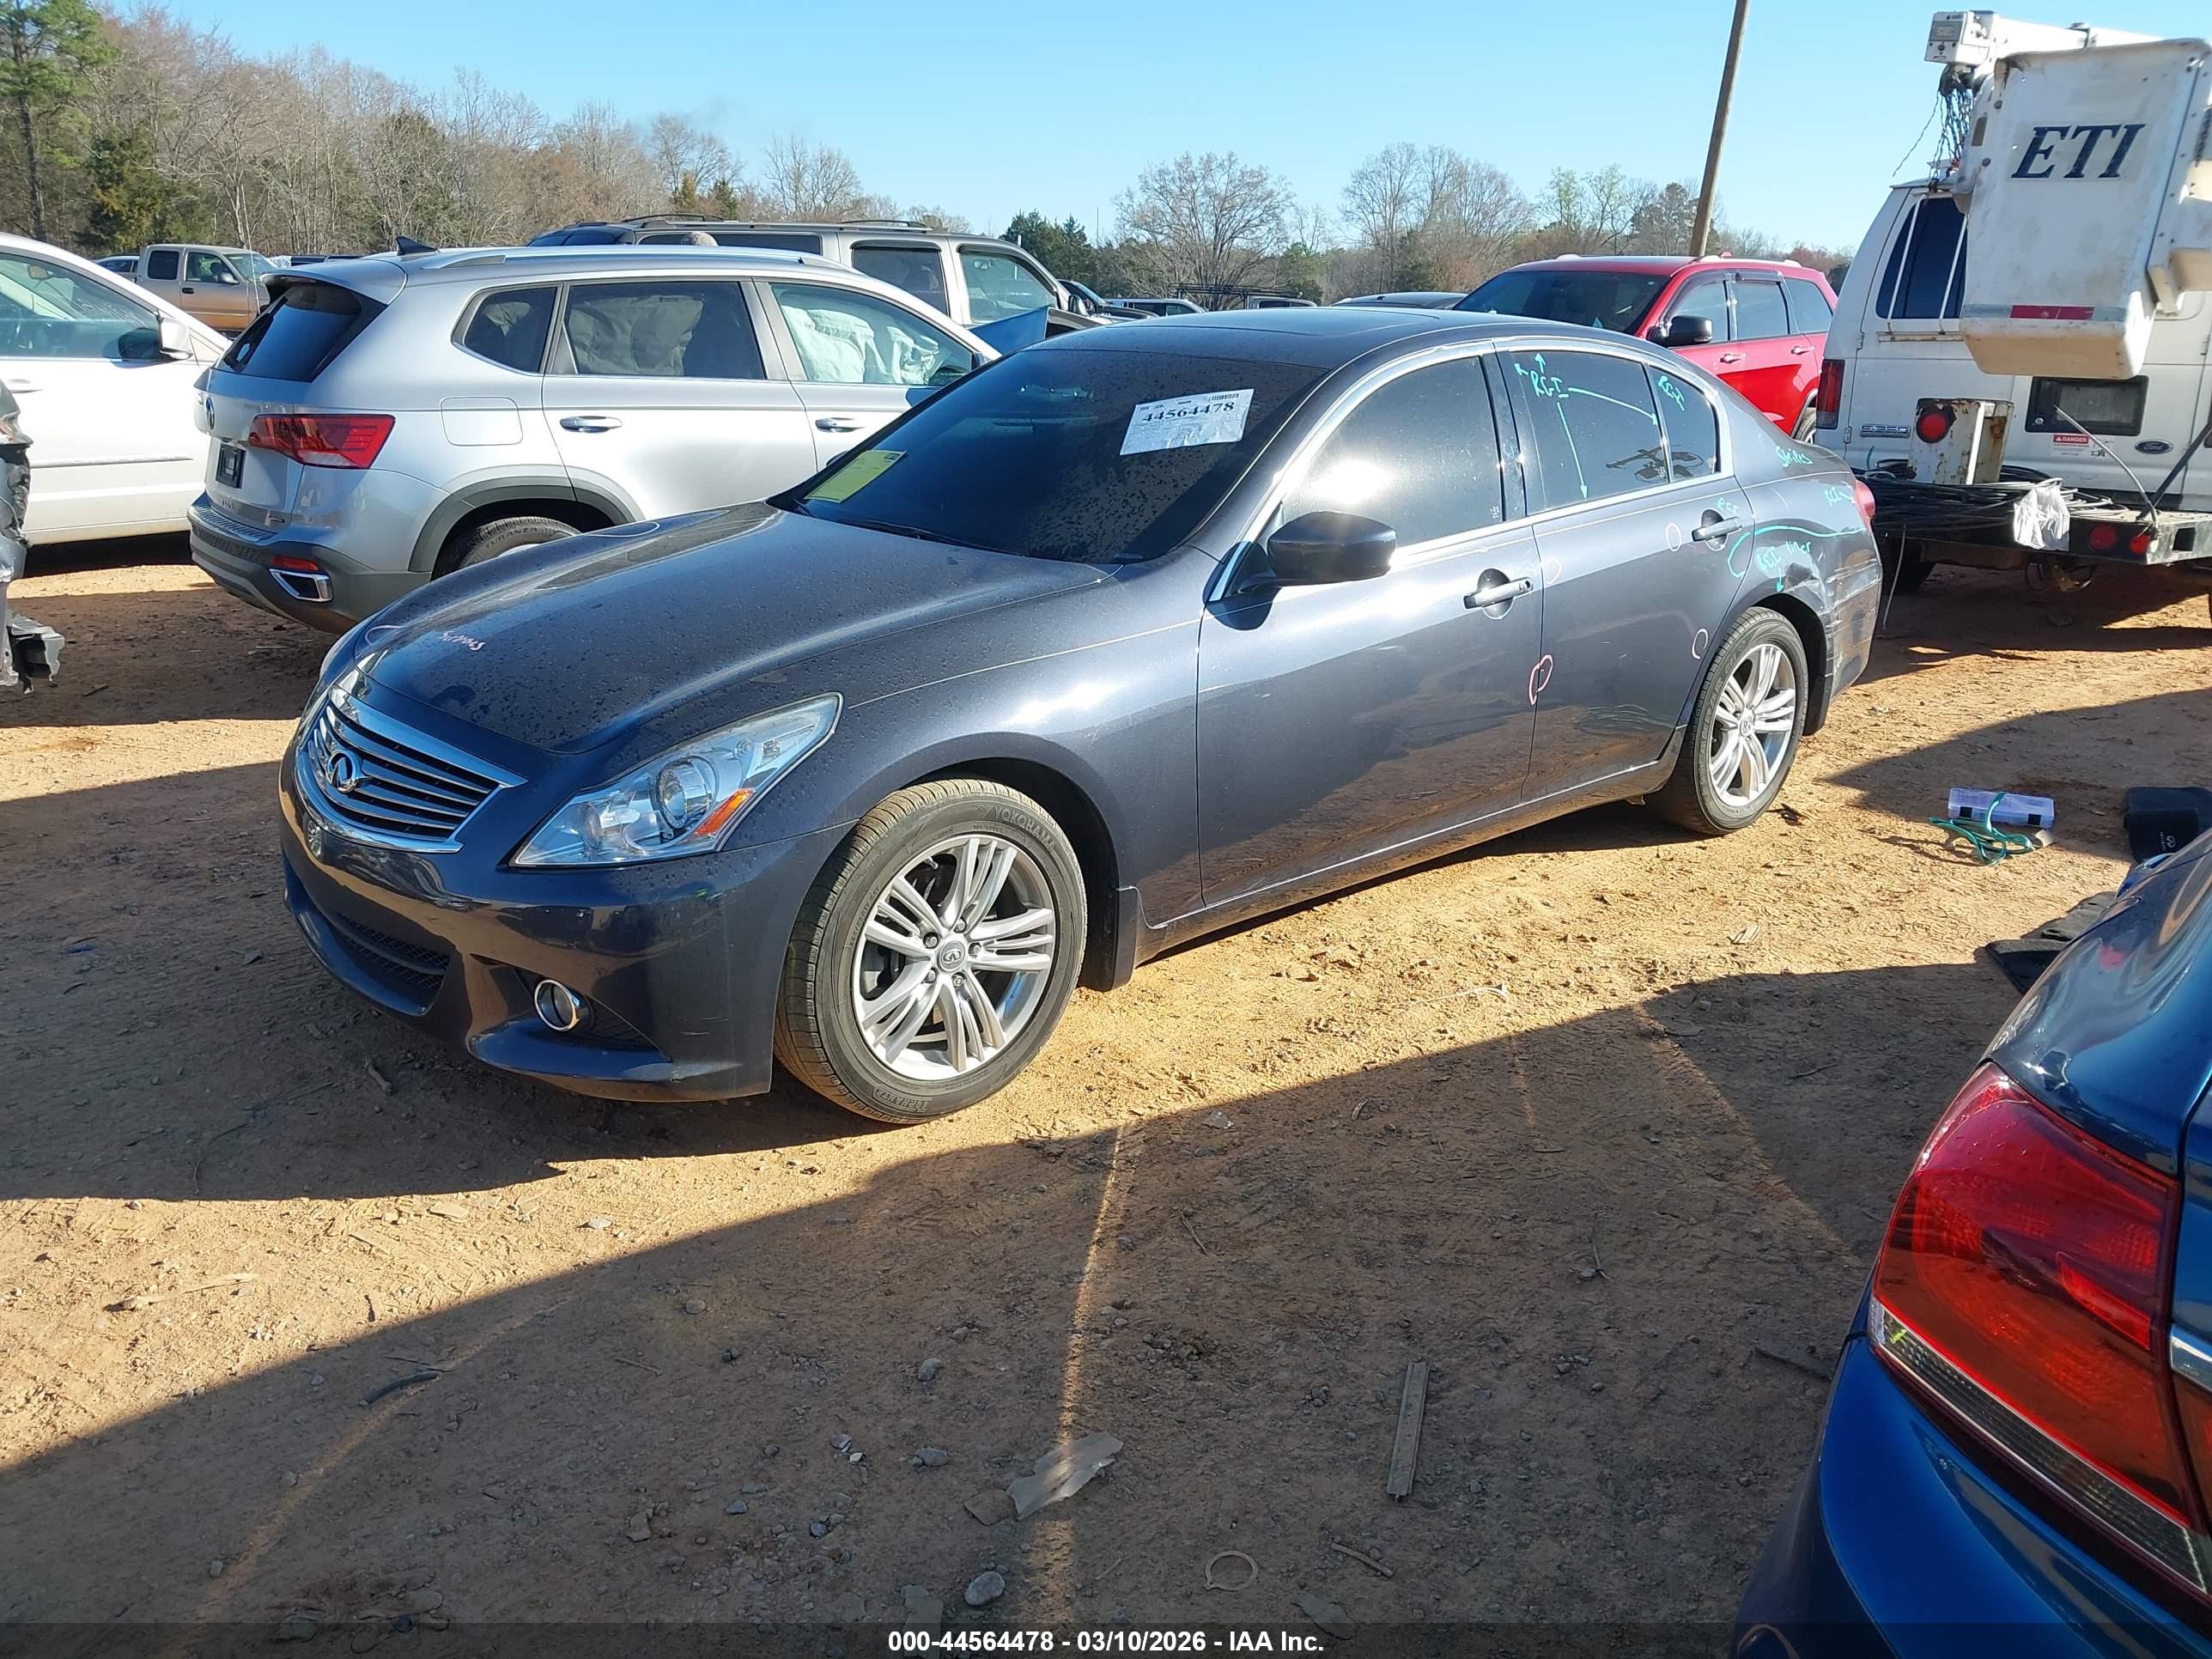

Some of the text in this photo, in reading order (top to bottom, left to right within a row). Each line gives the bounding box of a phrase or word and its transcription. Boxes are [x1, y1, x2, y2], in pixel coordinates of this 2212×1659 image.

[2011, 124, 2146, 179] ETI
[1143, 401, 1235, 422] 44564478
[994, 805, 1056, 852] YOKOHAMA
